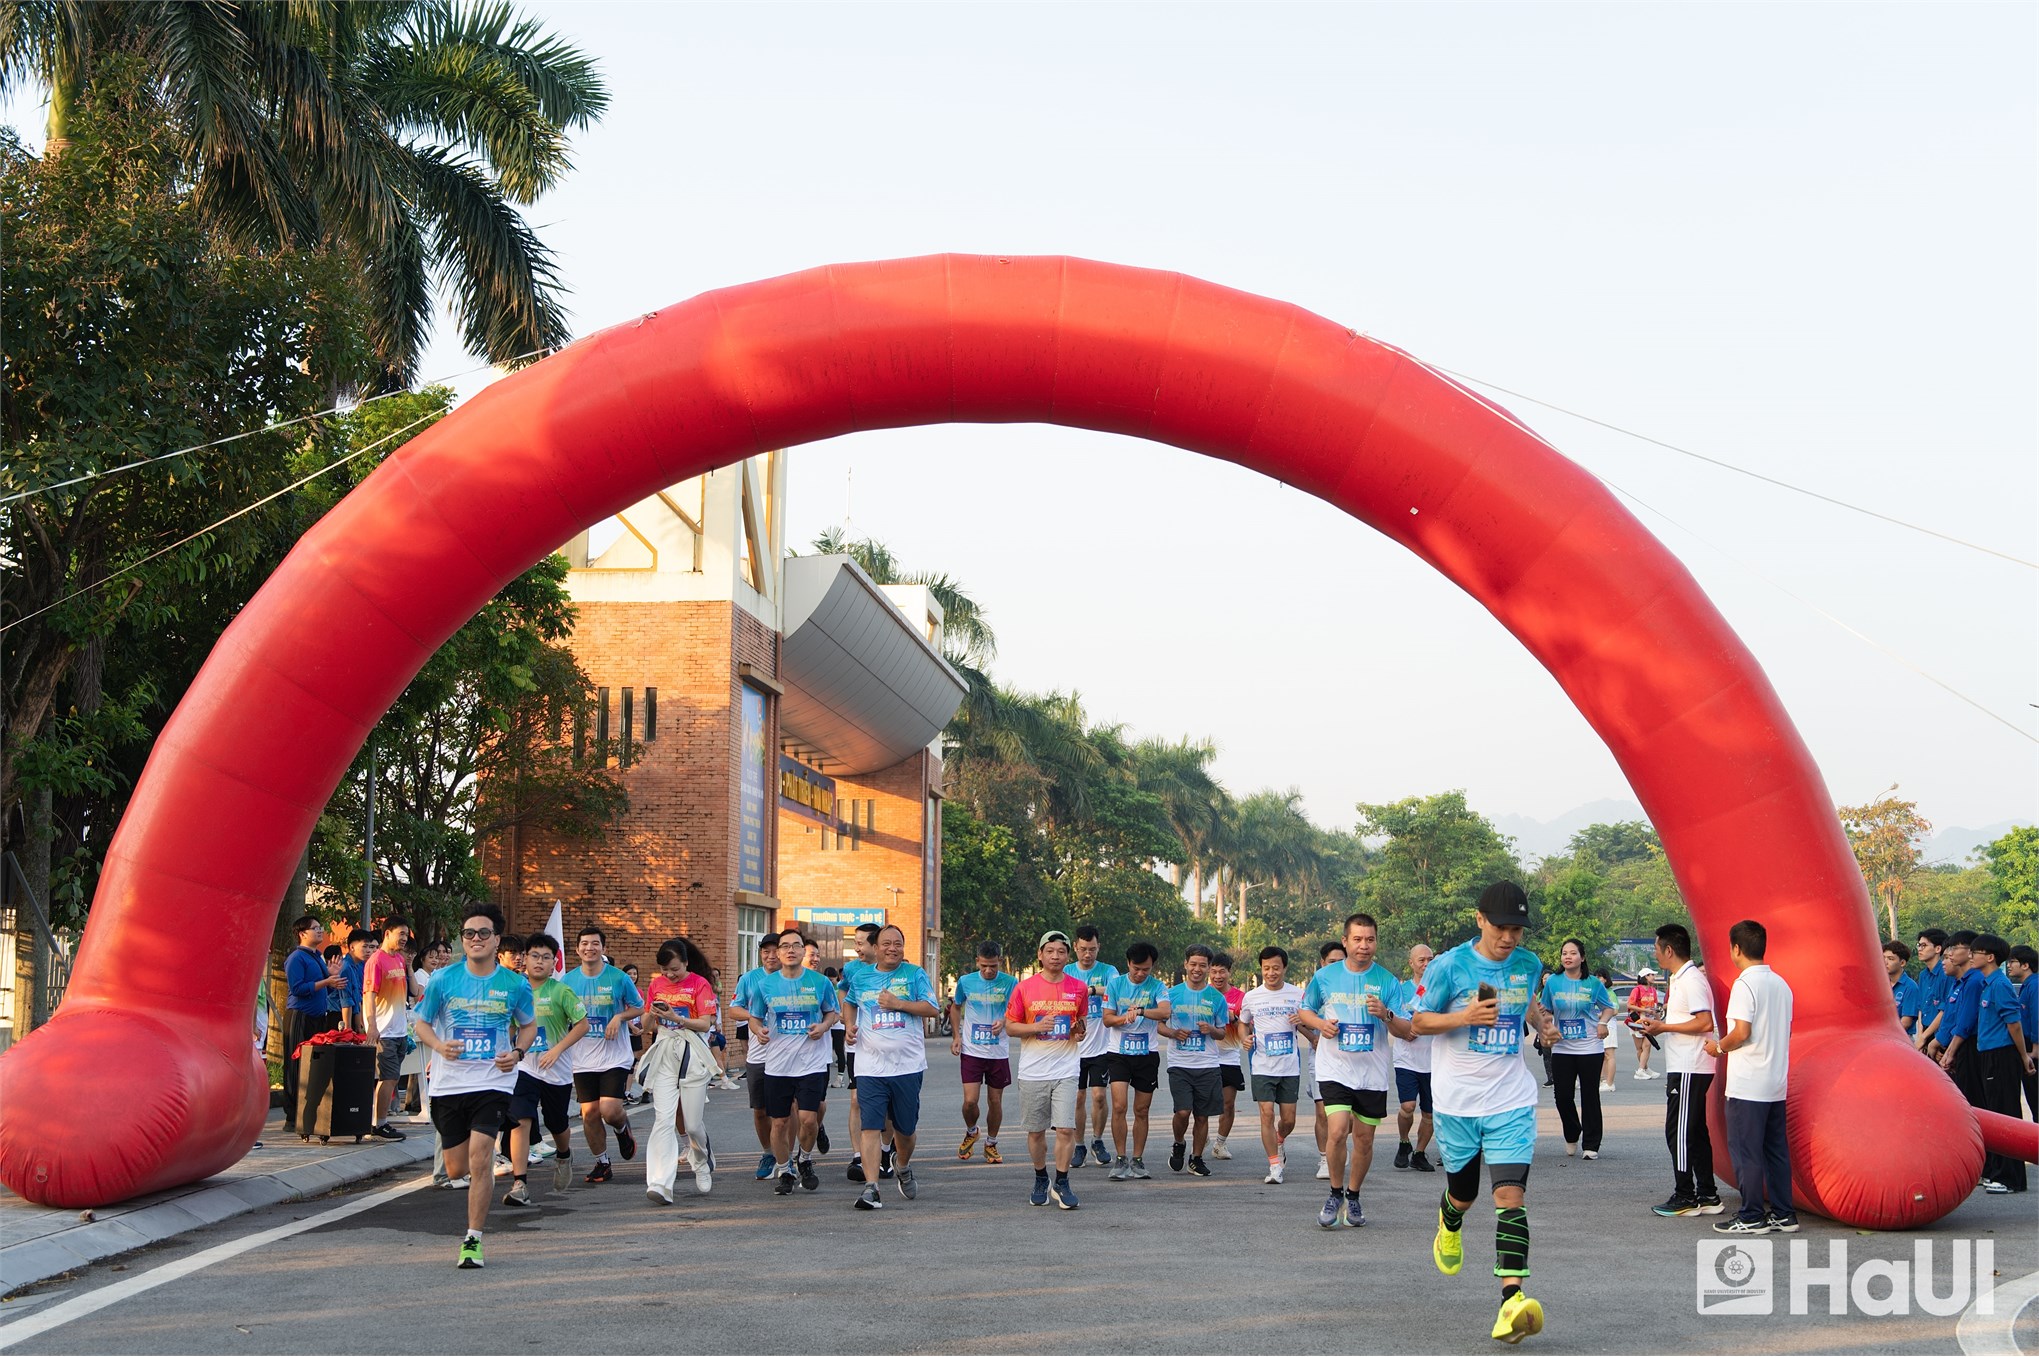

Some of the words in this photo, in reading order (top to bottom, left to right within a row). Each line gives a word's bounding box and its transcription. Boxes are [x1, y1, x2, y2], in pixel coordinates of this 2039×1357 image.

[875, 1012, 901, 1023] 6868
[781, 1019, 806, 1029] 5020
[1563, 1026, 1582, 1034] 5017
[1342, 1033, 1371, 1045] 5029
[1476, 1028, 1516, 1045] 5006
[1124, 1040, 1146, 1050] 5001
[1267, 1039, 1292, 1050] PACER
